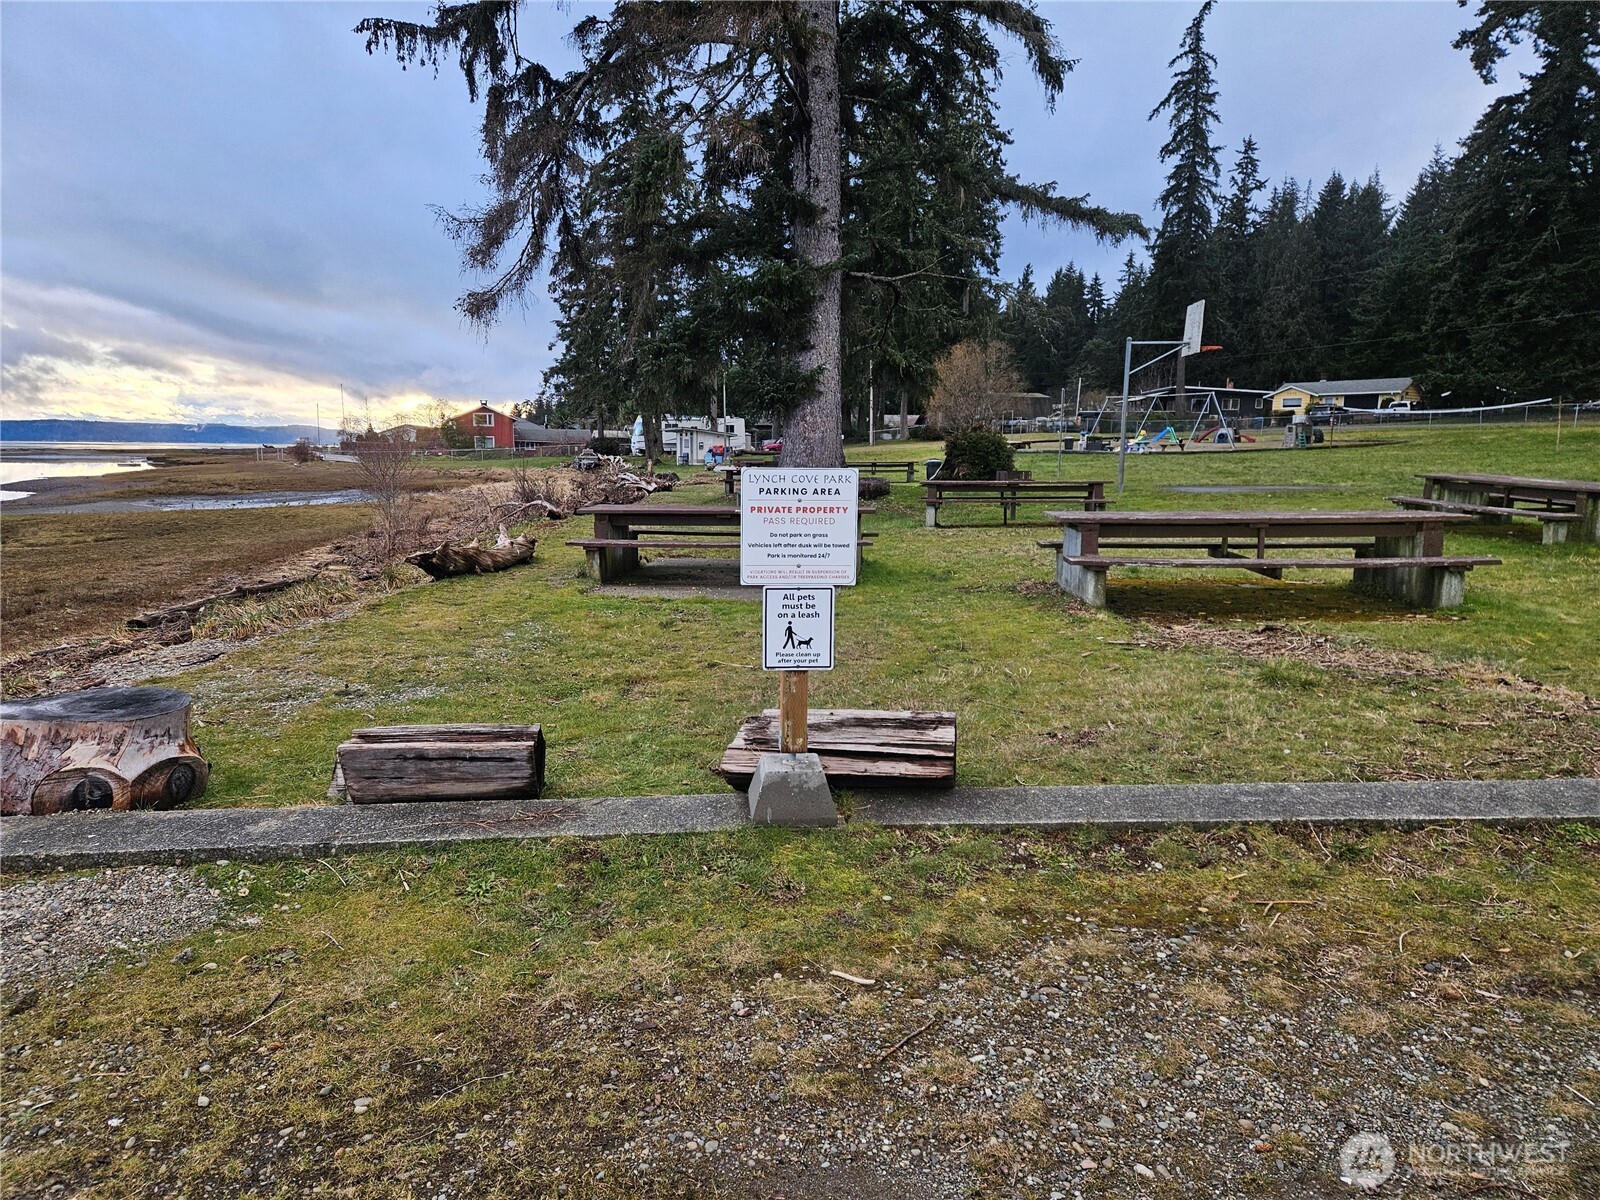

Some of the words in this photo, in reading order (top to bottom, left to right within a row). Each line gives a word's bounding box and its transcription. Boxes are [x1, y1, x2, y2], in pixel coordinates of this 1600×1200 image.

[749, 474, 785, 484] LYNCH
[792, 475, 818, 484] COVE
[824, 475, 852, 484] PARK
